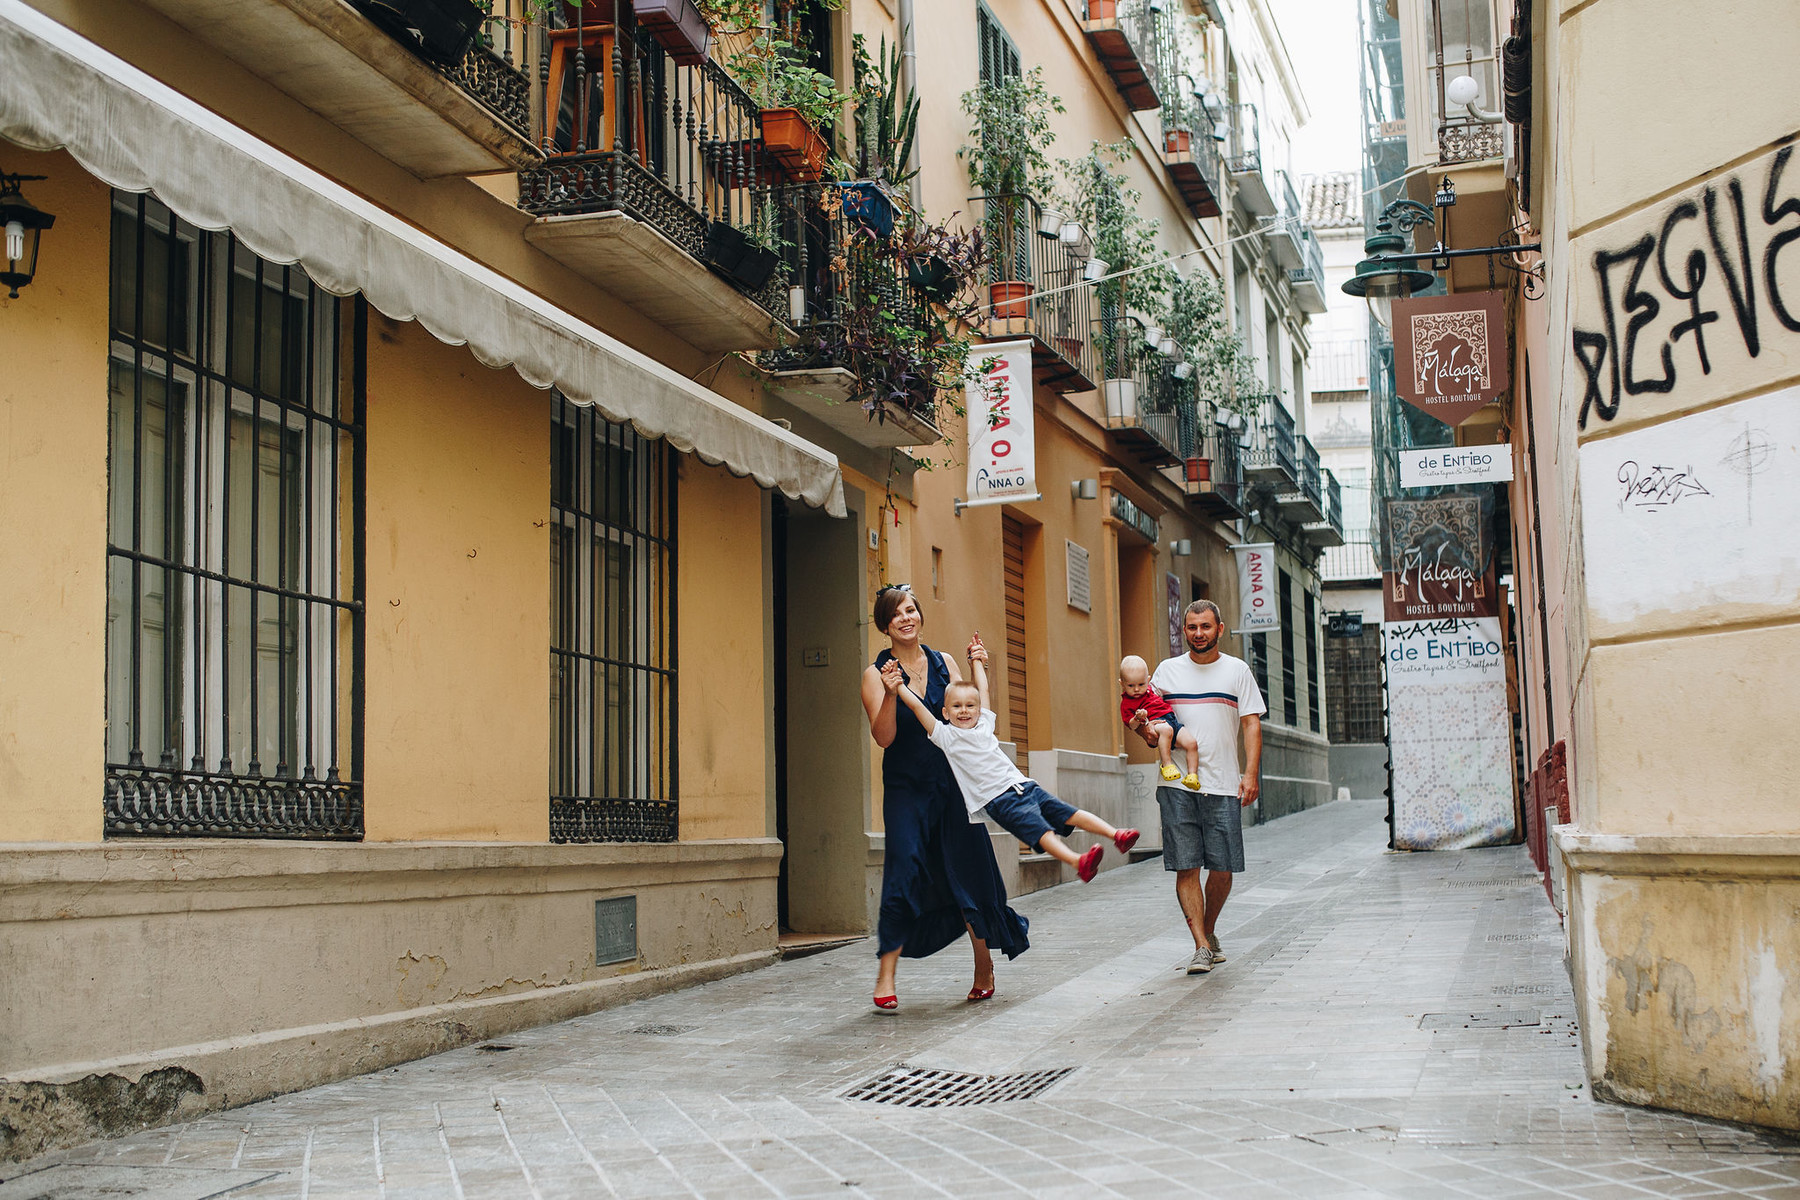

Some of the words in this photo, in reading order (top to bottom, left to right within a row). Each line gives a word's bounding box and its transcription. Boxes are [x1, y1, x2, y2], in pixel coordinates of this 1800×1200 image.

[1421, 345, 1483, 395] Málaga
[1425, 396, 1449, 404] HOSTEL
[1450, 393, 1481, 402] BOUTIQUE
[1418, 456, 1437, 469] de
[1249, 552, 1263, 594] ANNA
[1401, 540, 1475, 603] Málaga
[1406, 604, 1435, 615] HOSTEL
[1437, 602, 1475, 613] BOUTIQUE
[1390, 643, 1418, 661] de
